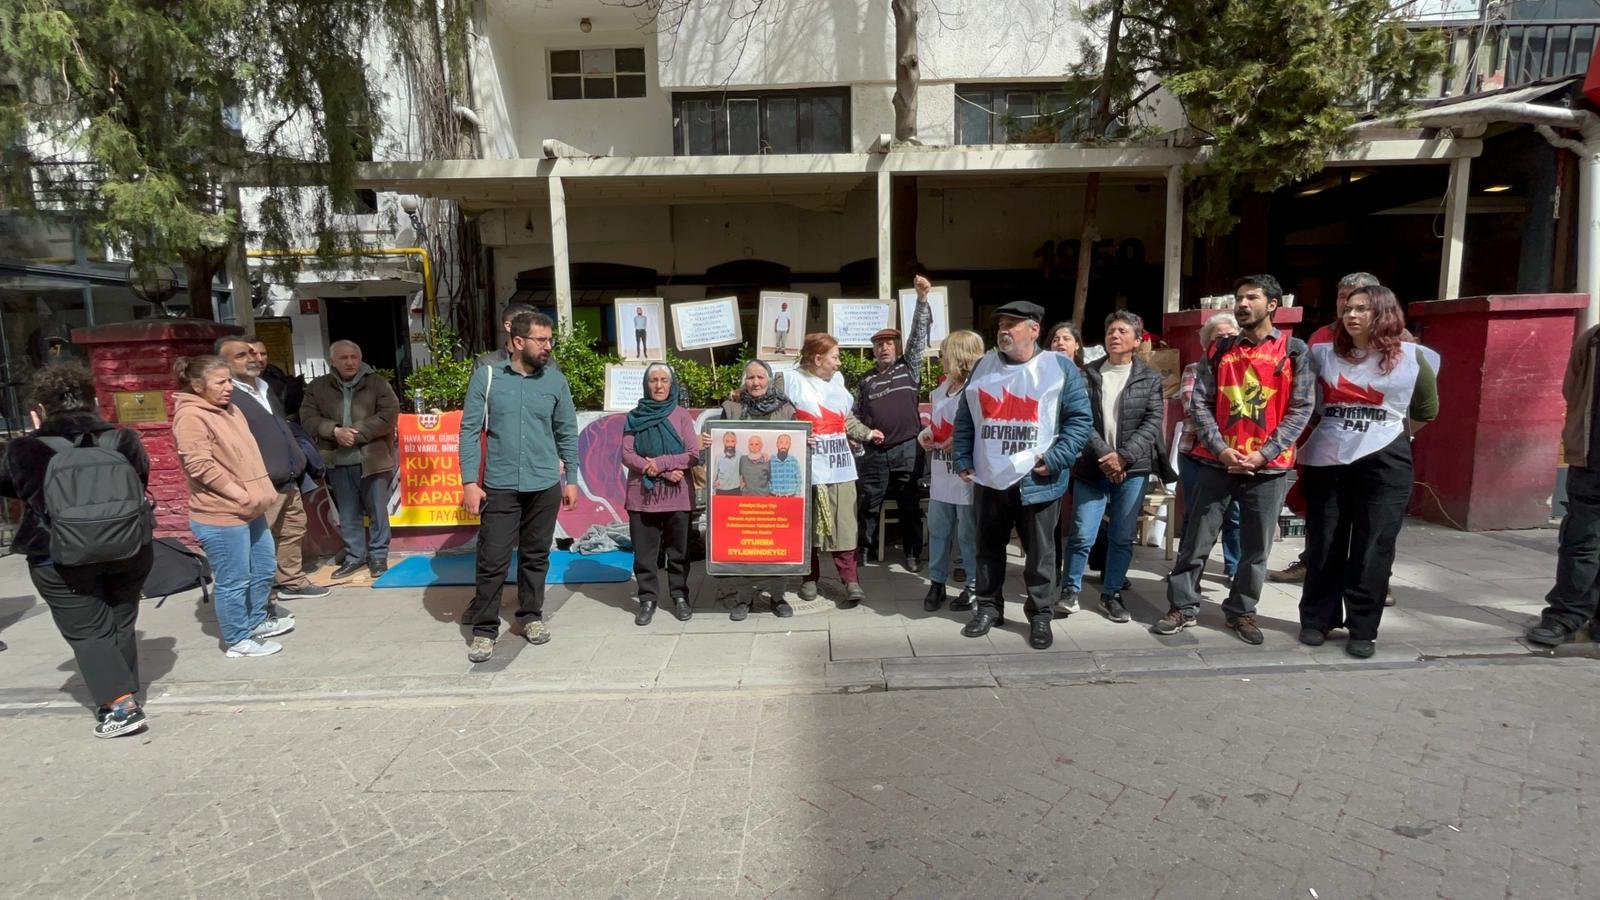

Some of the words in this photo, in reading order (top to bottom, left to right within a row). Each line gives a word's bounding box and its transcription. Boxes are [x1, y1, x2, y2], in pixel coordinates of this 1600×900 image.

[404, 434, 421, 443] HAVA
[404, 443, 416, 453] BİZ
[406, 456, 453, 470] KUYU
[740, 538, 774, 546] OTURMA
